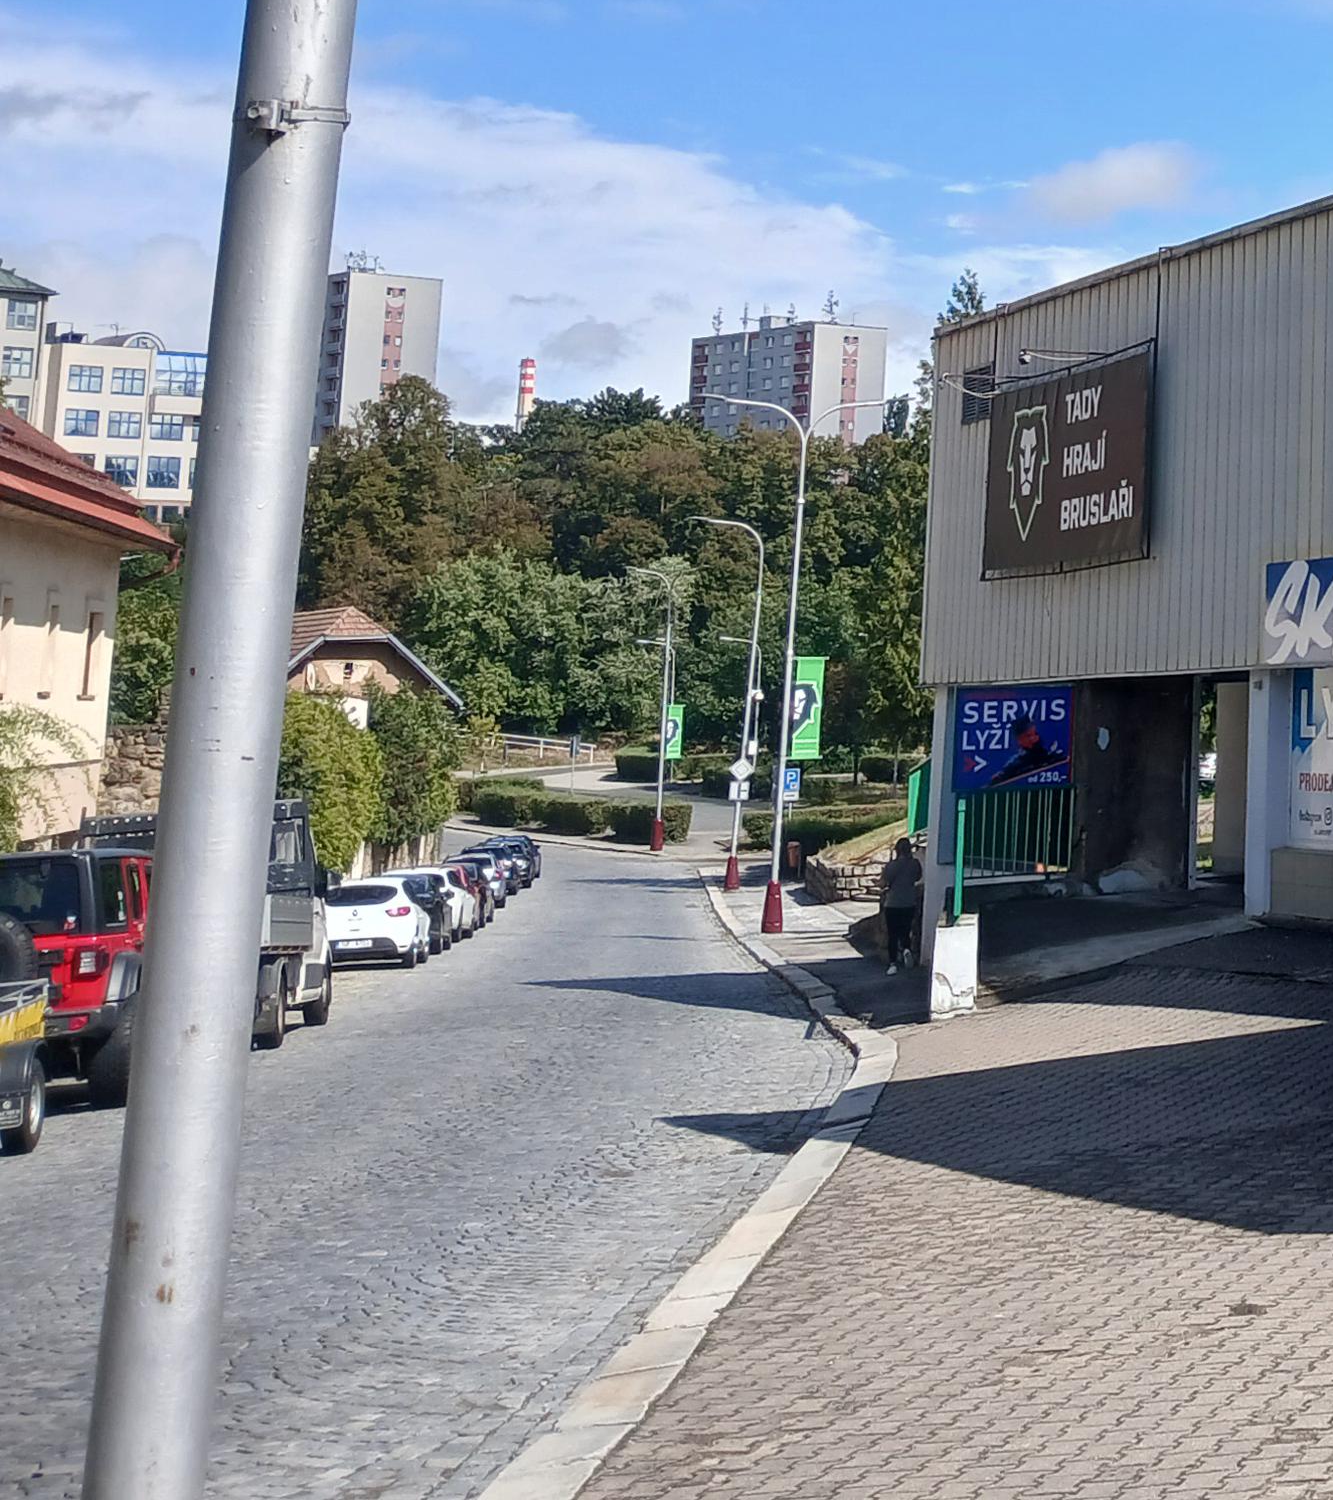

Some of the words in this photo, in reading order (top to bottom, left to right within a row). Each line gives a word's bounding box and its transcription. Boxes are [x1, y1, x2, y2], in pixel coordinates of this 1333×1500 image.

[1065, 385, 1102, 424] TADY
[1062, 430, 1106, 478] HRAJÍ
[1060, 479, 1133, 531] BRUSLAŘI
[962, 699, 1066, 723] SERVIS
[962, 723, 1012, 750] LYŽÍ
[786, 771, 796, 784] P
[1299, 772, 1333, 792] PRODEJ
